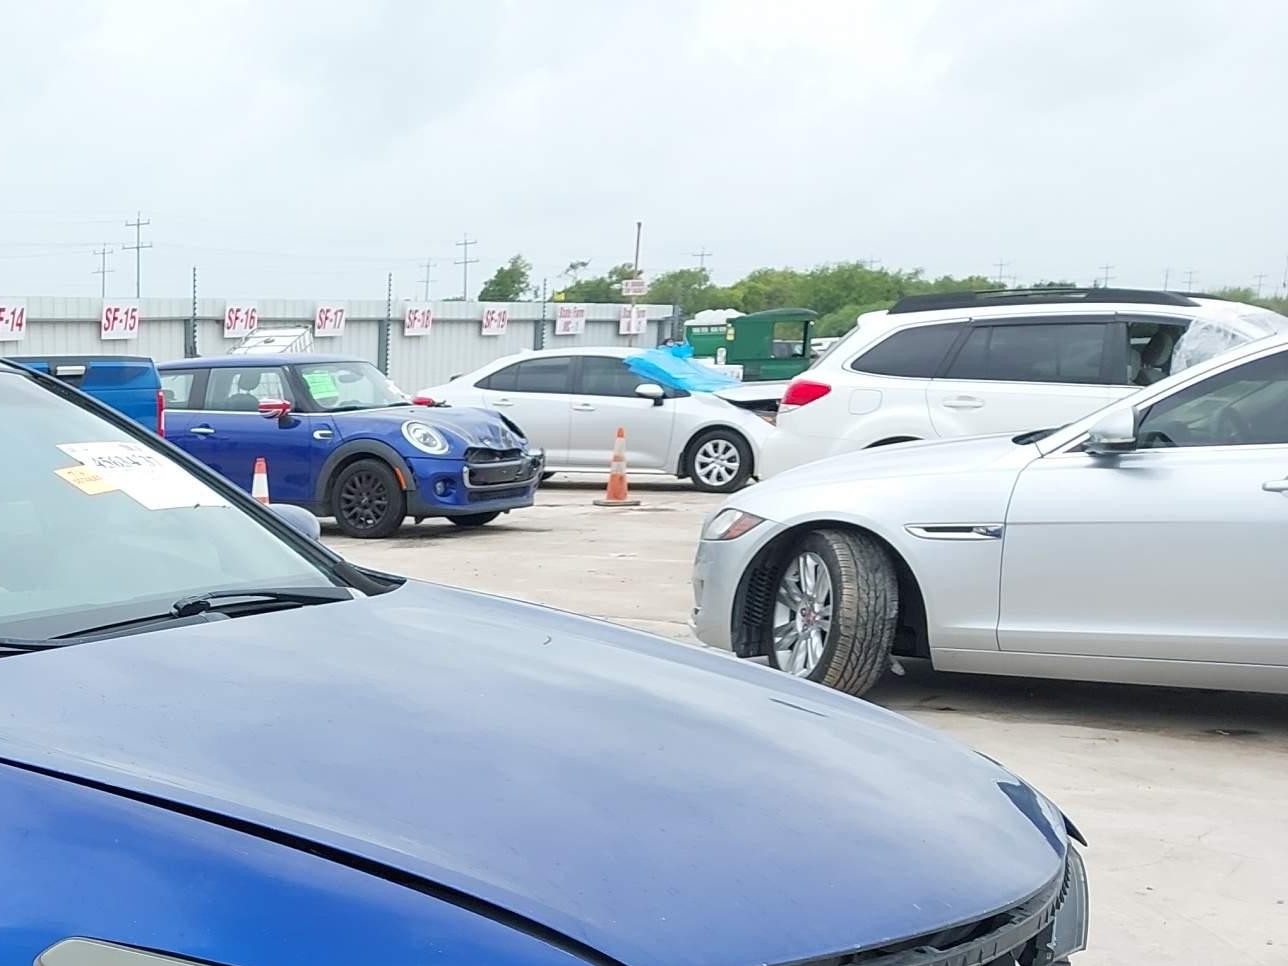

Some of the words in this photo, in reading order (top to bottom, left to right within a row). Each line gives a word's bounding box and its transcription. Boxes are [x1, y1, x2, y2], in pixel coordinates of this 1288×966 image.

[103, 306, 137, 332] SF-15
[226, 307, 257, 330] SF-16
[317, 307, 344, 329] SF-17
